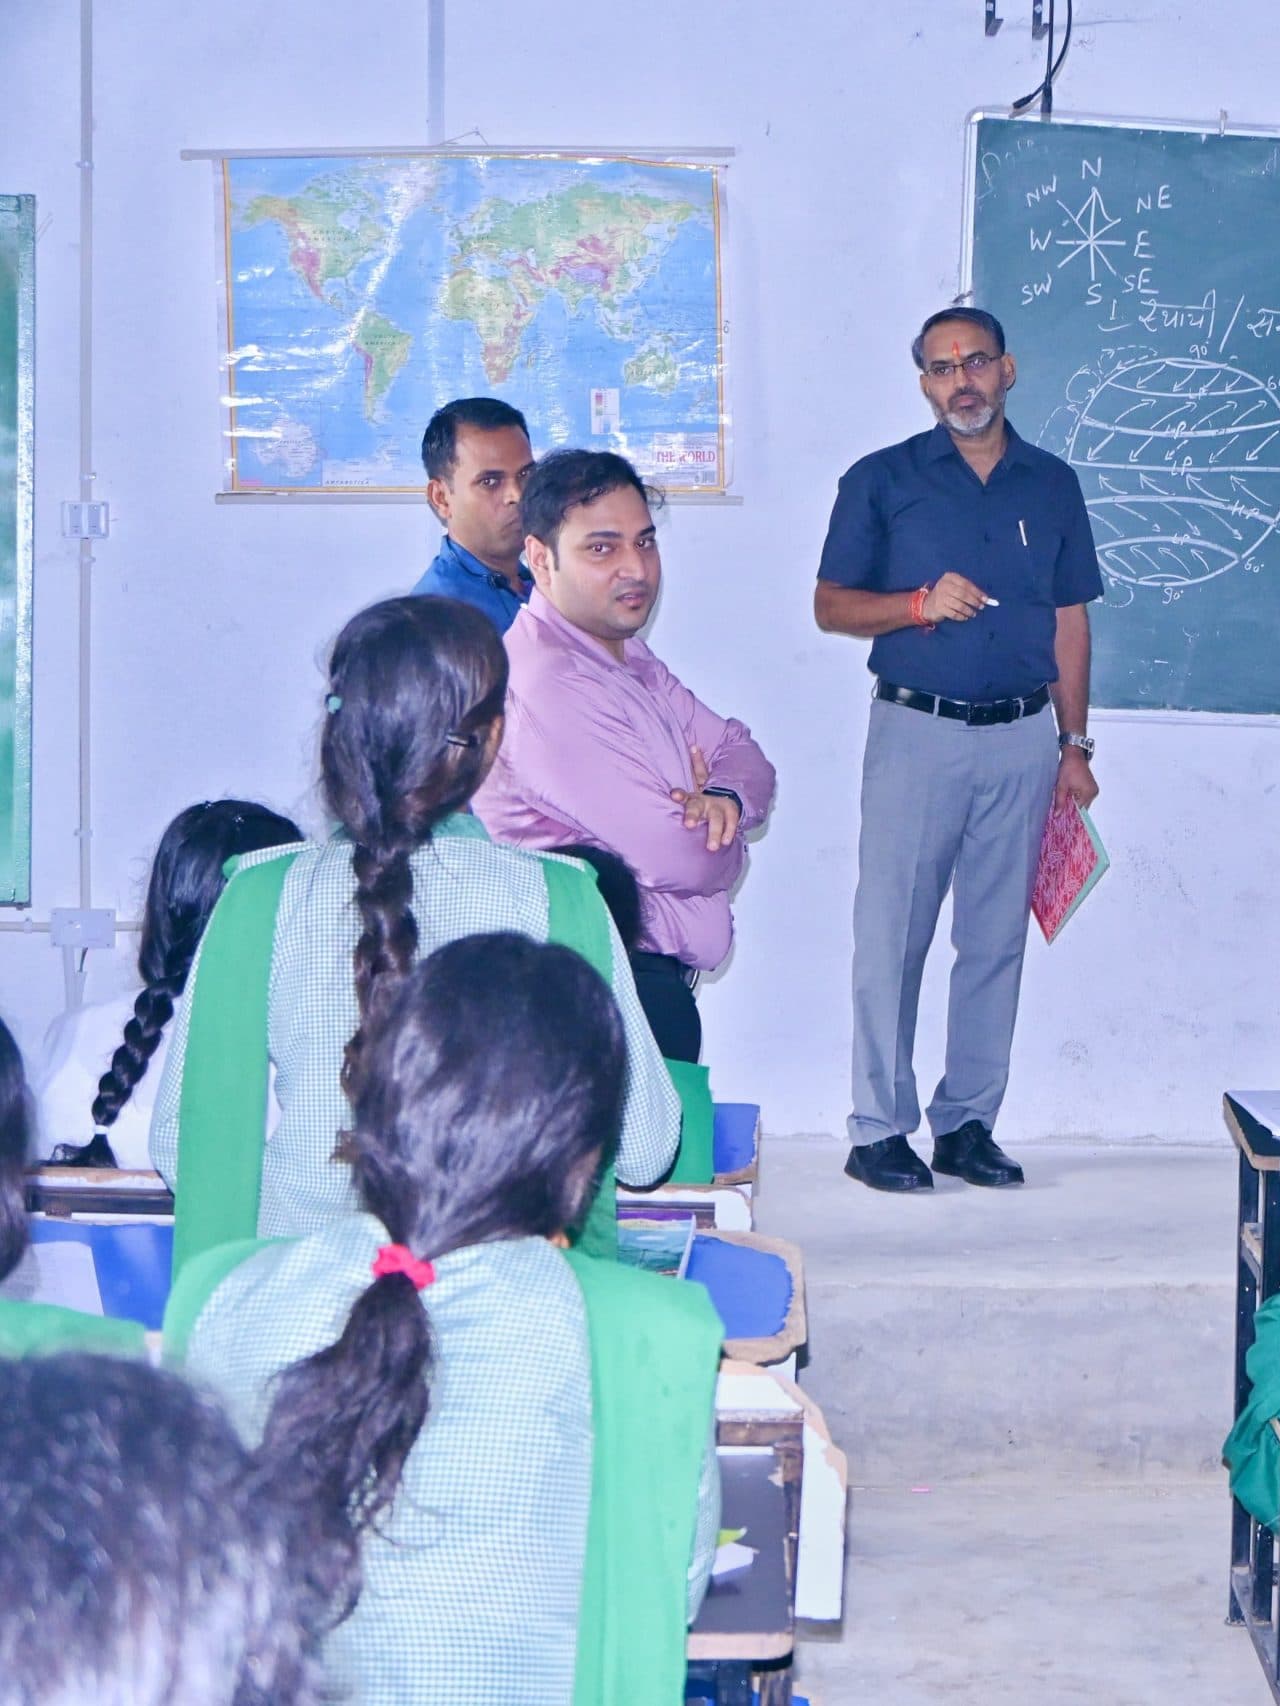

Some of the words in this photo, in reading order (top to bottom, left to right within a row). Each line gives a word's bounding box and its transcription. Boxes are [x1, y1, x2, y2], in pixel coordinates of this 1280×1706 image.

[1081, 156, 1102, 180] N
[1026, 174, 1057, 207] NW
[1136, 185, 1173, 214] NE
[1030, 228, 1052, 251] W
[1134, 230, 1155, 258] E
[1022, 274, 1052, 306] SW
[1085, 282, 1102, 306] S
[1122, 267, 1159, 294] SE
[656, 451, 676, 463] THE
[679, 450, 716, 463] WORLD
